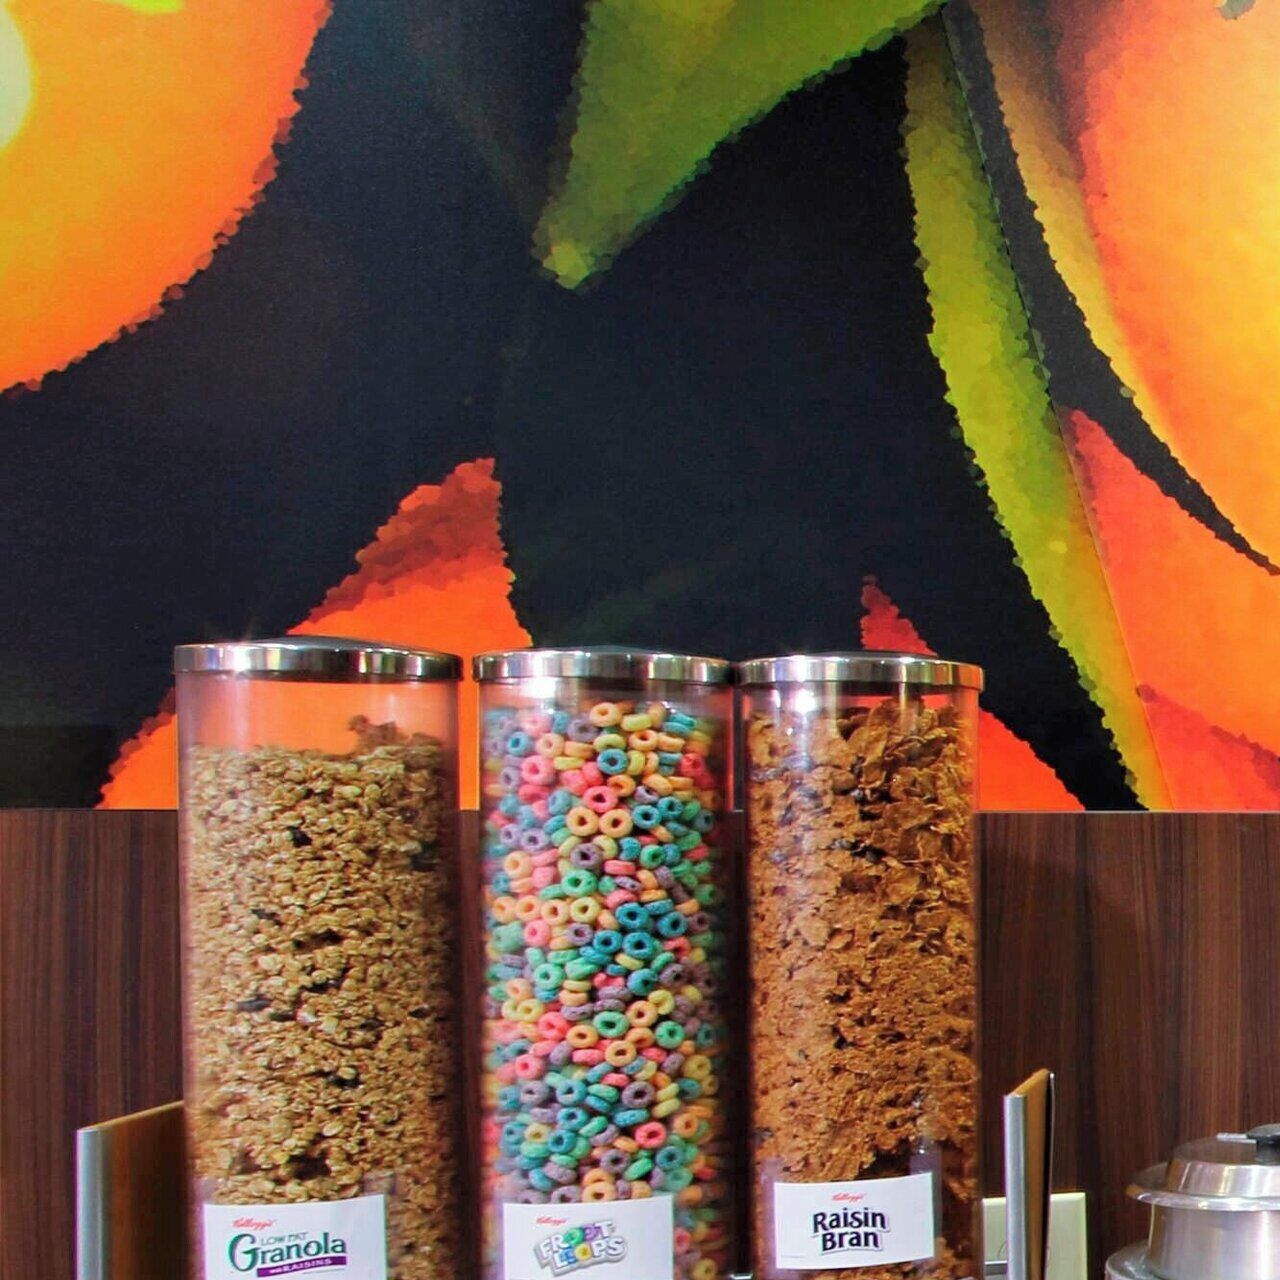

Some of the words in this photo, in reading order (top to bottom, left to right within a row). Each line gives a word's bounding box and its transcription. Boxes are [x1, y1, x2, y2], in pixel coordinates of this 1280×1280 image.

[813, 1207, 886, 1233] Raisin
[228, 1232, 347, 1272] Granola
[821, 1231, 879, 1251] Bran
